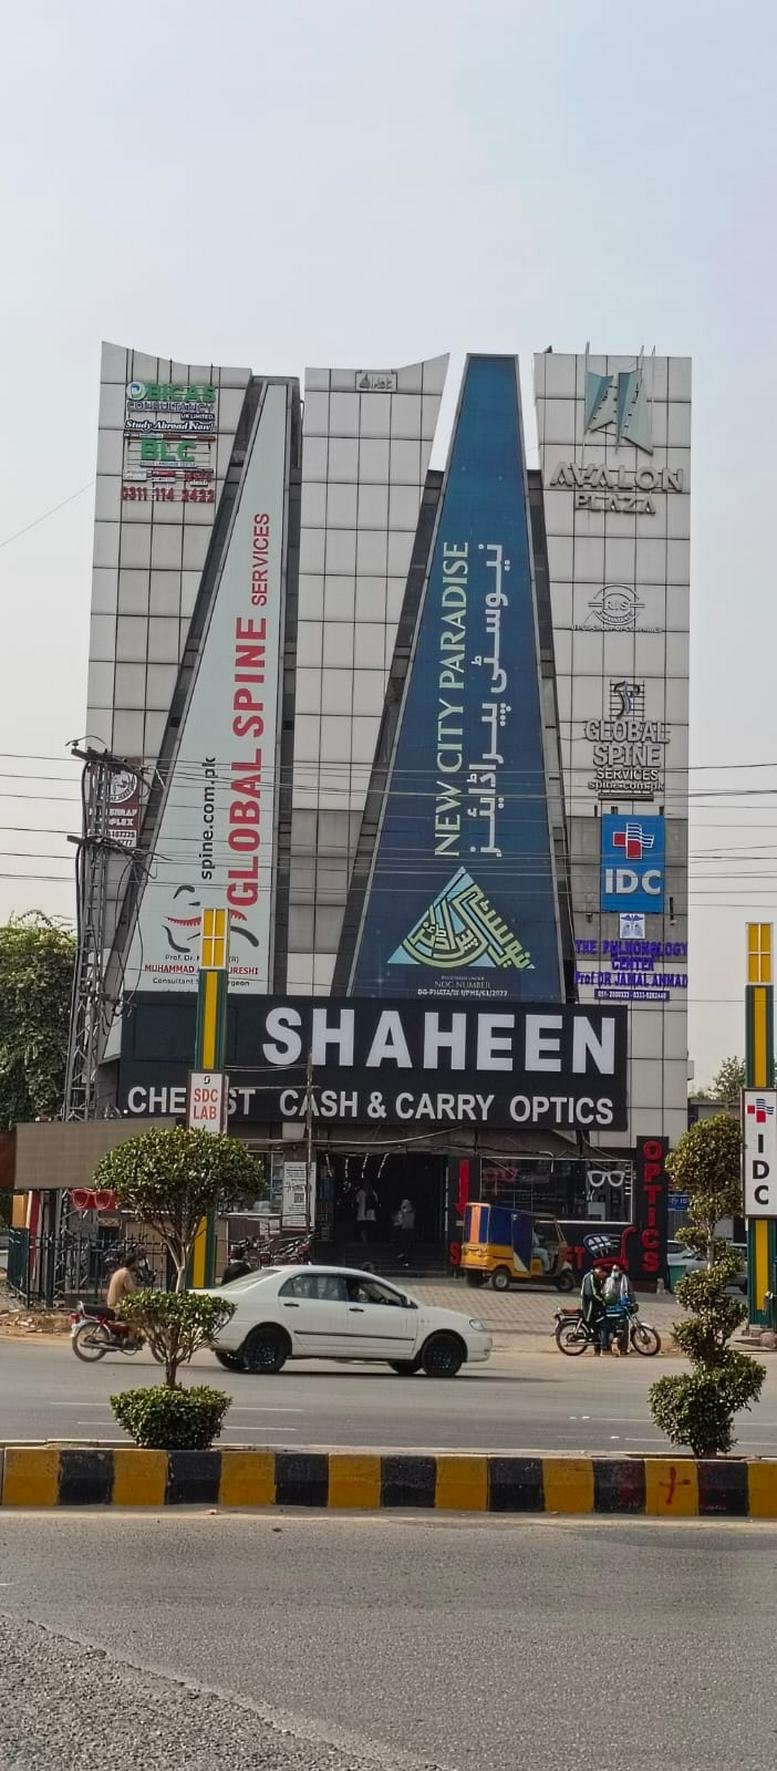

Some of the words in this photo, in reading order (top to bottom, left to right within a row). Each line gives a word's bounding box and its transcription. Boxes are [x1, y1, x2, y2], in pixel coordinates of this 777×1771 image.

[125, 420, 153, 432] Study
[153, 420, 188, 431] Abroad
[140, 438, 197, 462] BLC
[550, 461, 684, 492] AVALON
[155, 487, 175, 502] 114
[575, 494, 656, 516] PLAZA
[251, 513, 270, 607] SERVICES
[439, 542, 469, 689] PARADISE
[232, 617, 267, 738] SPINE
[437, 698, 464, 773] CITY
[584, 719, 671, 744] GLOBAL
[592, 744, 661, 768] SPINE
[596, 768, 659, 781] SERVICES
[201, 757, 216, 880] spine.com.pk
[226, 748, 262, 906] GLOBAL
[434, 780, 462, 856] NEW
[605, 868, 661, 895] IDC
[165, 953, 183, 961] Prof.
[575, 939, 597, 954] THE
[602, 940, 688, 957] PULMONOLOGY
[144, 964, 195, 973] MUHAMMAD
[153, 977, 194, 985] Consultant
[614, 972, 650, 987] JAMAL
[262, 1007, 615, 1074] SHAHEEN
[127, 1086, 256, 1116] CHEST
[279, 1089, 358, 1118] CASH
[367, 1091, 387, 1119] &
[395, 1093, 495, 1121] CARRY
[509, 1095, 614, 1125] OPTICS
[193, 1088, 218, 1103] SDC
[193, 1105, 217, 1120] LAB
[752, 1134, 770, 1206] IDC
[641, 1140, 664, 1272] OPTICS
